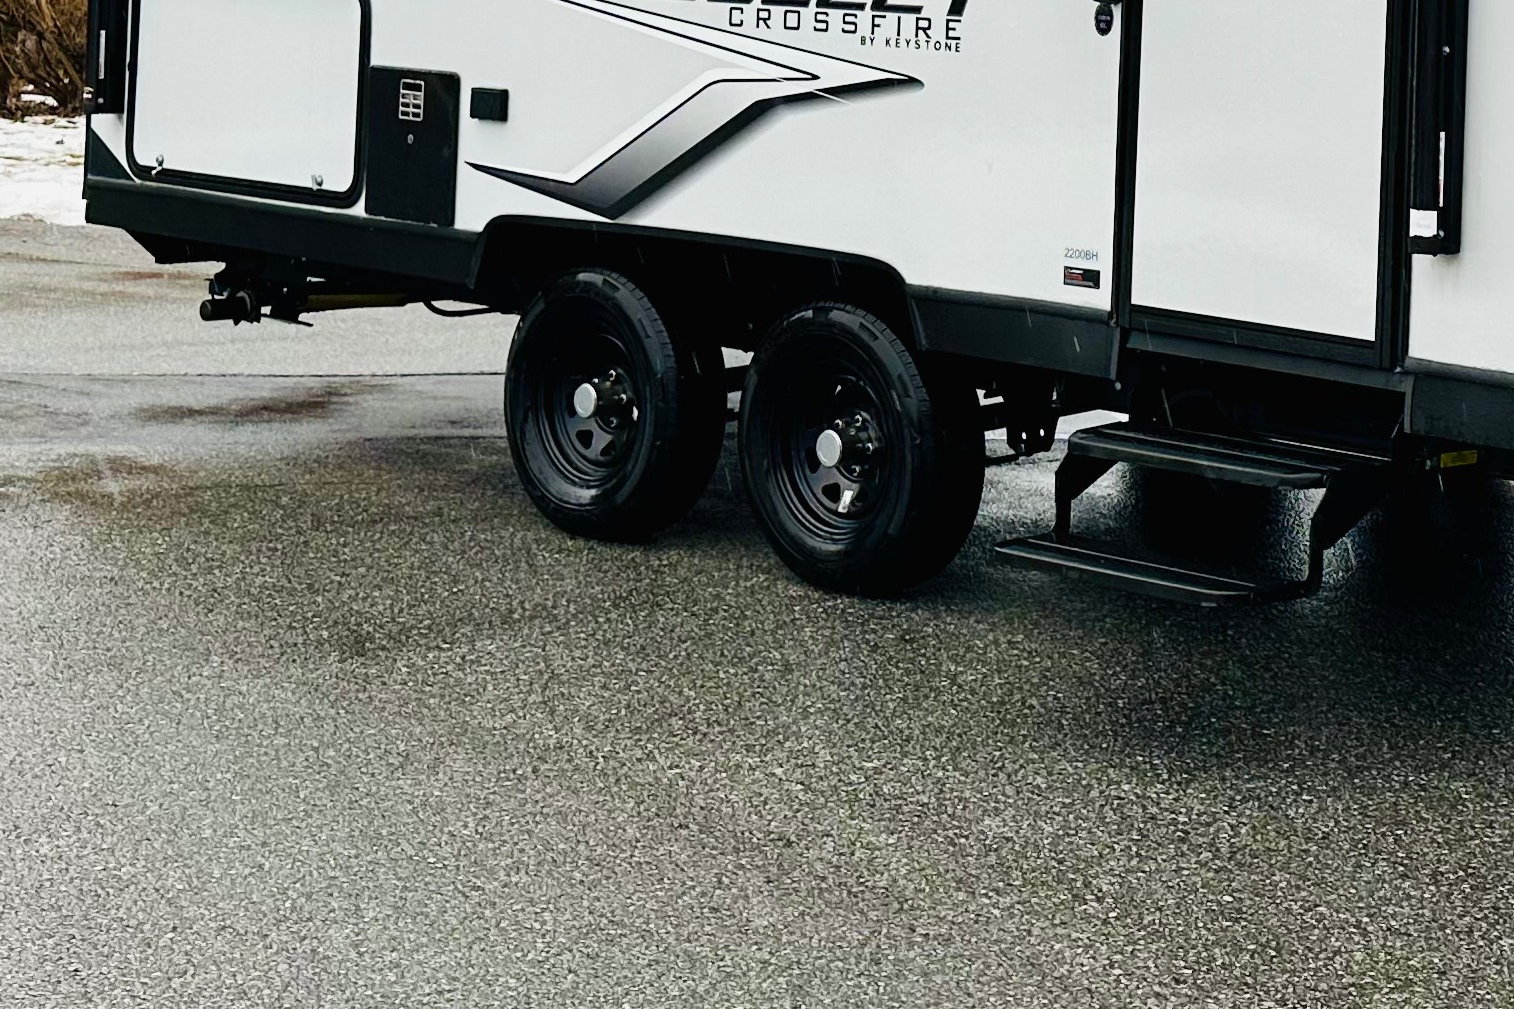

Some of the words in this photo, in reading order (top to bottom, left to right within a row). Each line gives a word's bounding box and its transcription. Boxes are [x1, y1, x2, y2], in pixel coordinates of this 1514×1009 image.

[728, 6, 962, 41] CROSSFIRE
[860, 35, 876, 46] BY
[885, 37, 962, 53] KEYSTONE
[1064, 247, 1099, 261] 2200BH
